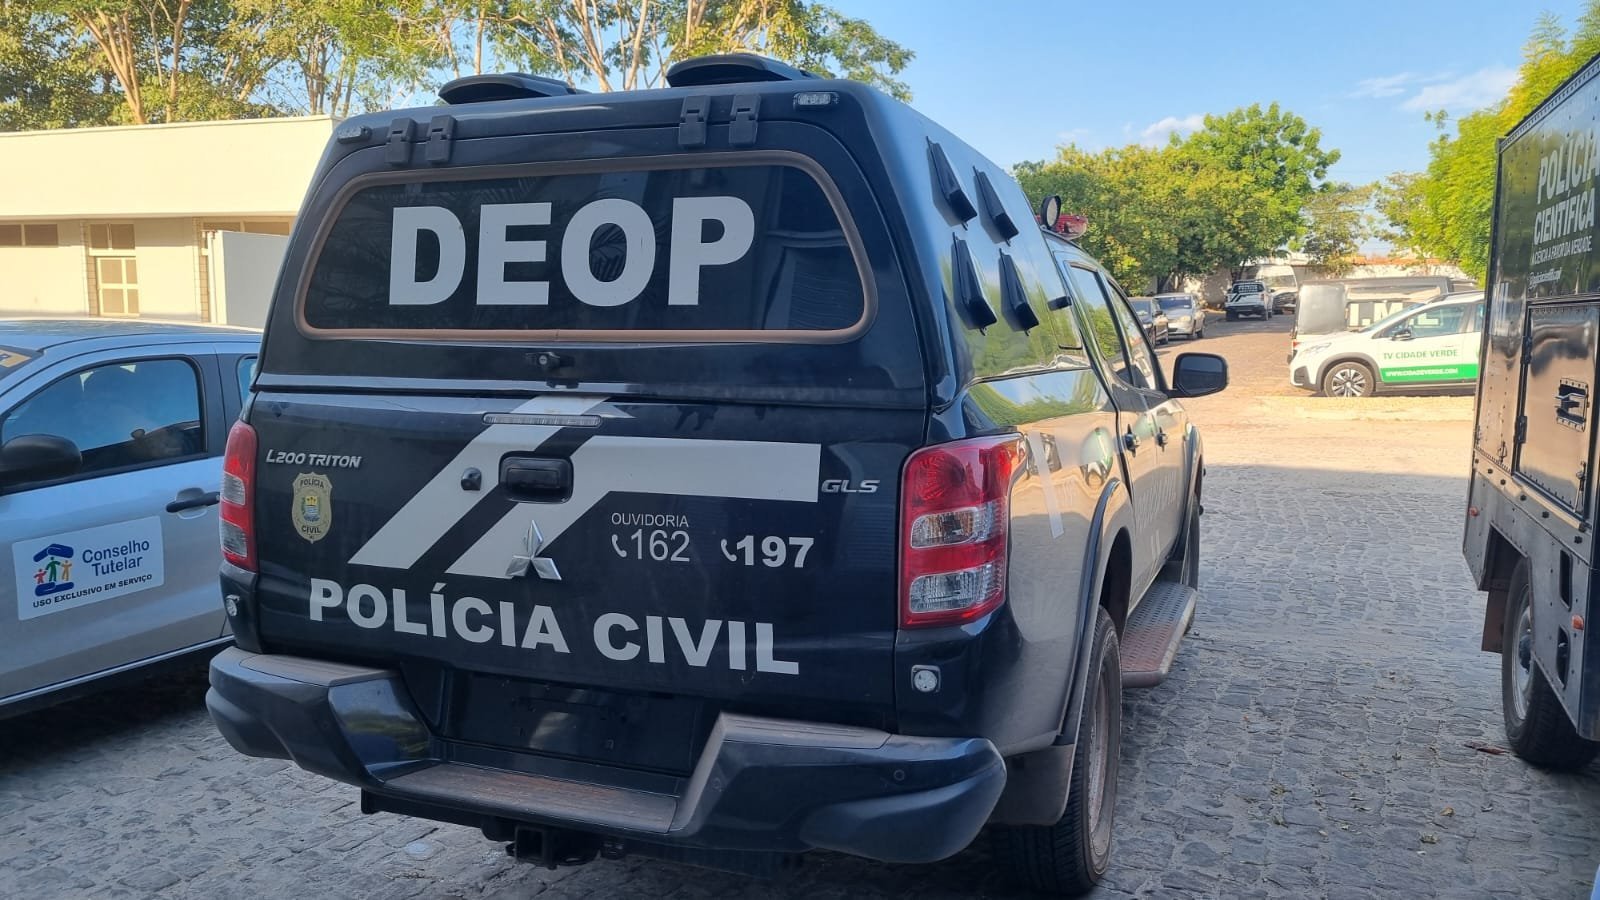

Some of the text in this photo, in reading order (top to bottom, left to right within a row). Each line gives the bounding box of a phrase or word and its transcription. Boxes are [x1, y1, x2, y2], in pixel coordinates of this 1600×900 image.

[1537, 128, 1600, 204] POLÍCIA
[1533, 187, 1595, 246] CIENTÍFICA
[388, 195, 756, 307] DEOP
[1383, 349, 1458, 360] TV CIDADE VERDE
[265, 449, 362, 469] L200 TRITON
[300, 478, 325, 489] POLÍCIA
[821, 479, 881, 493] GLS
[301, 524, 322, 535] CIVIL
[611, 512, 690, 528] OUVIDORIA
[82, 539, 150, 564] Conselho
[630, 528, 691, 562] 162
[736, 535, 815, 569] 197
[91, 555, 144, 577] Tutelar
[32, 573, 153, 608] USO EXCLUSIVO EM SERVIÇO
[308, 577, 799, 675] POLÍCIA CIVIL
